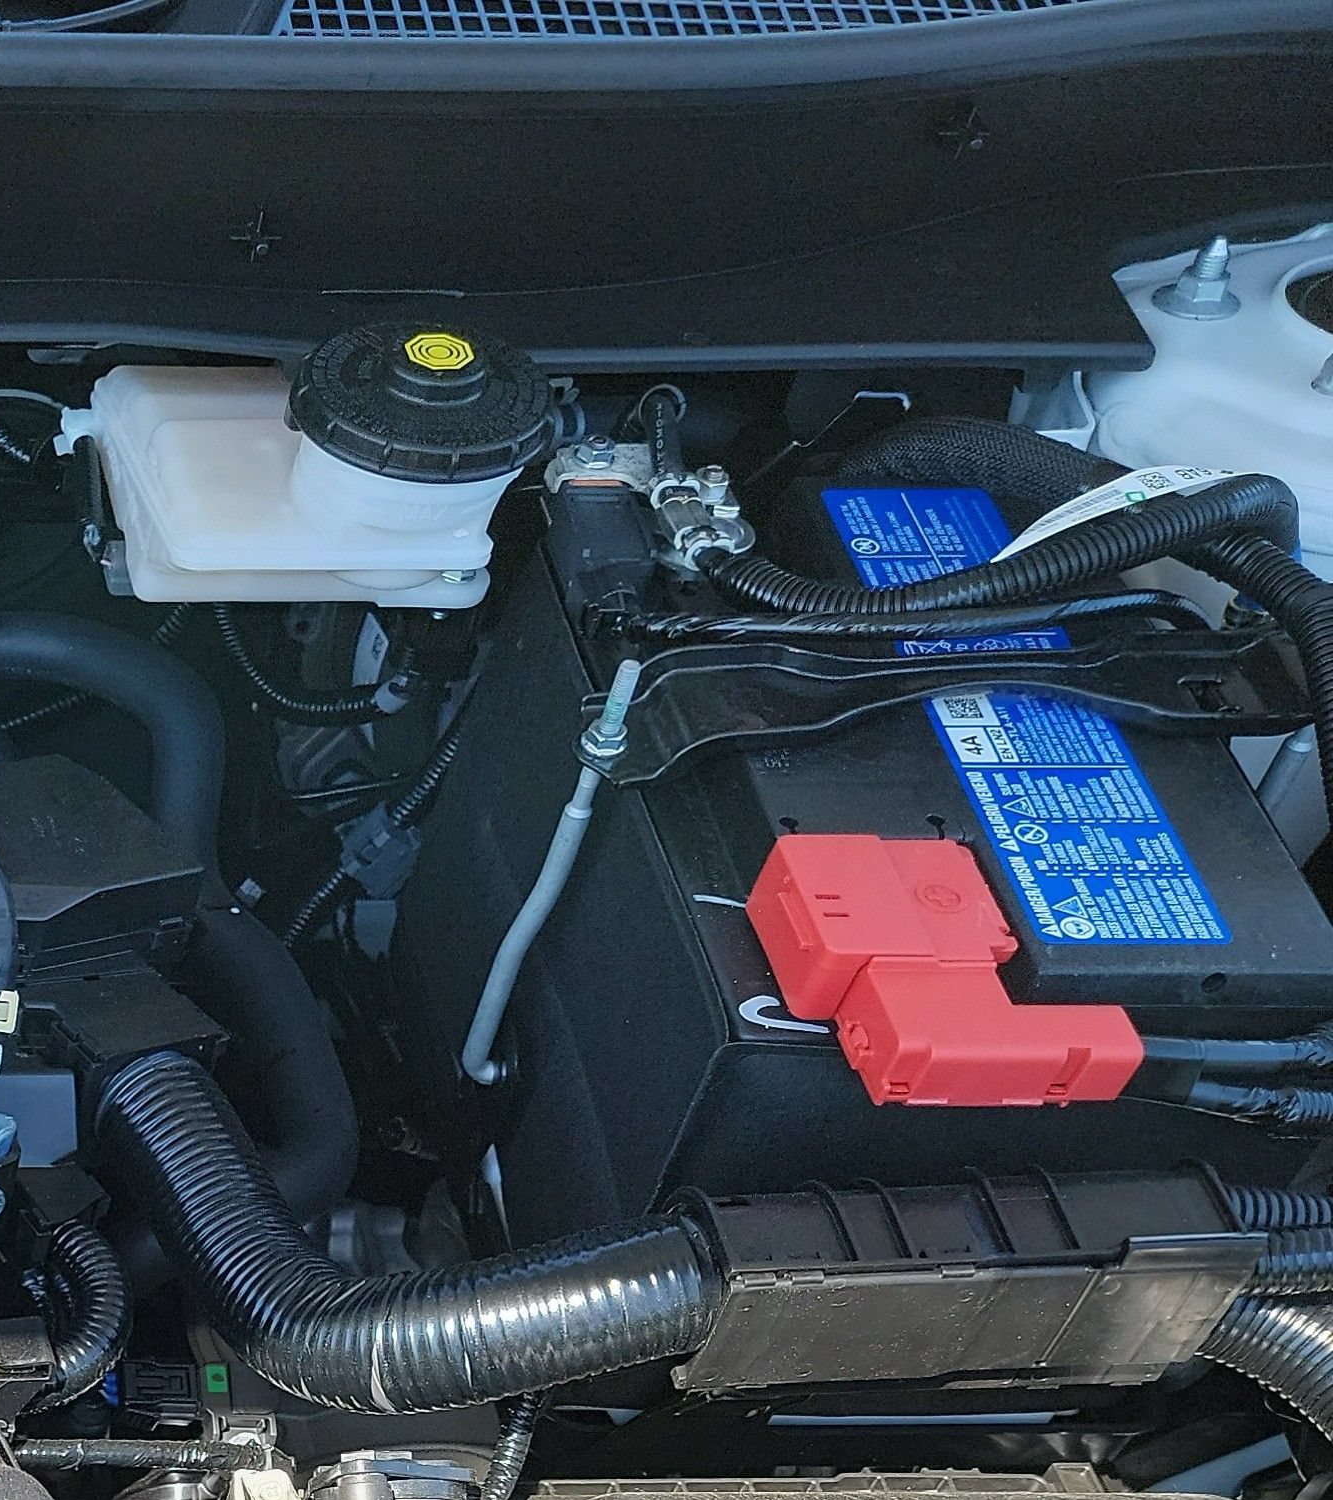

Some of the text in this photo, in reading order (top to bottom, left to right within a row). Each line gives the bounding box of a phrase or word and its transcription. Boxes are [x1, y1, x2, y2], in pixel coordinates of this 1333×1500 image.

[959, 735, 984, 755] 4A
[988, 729, 1015, 759] EN LN2
